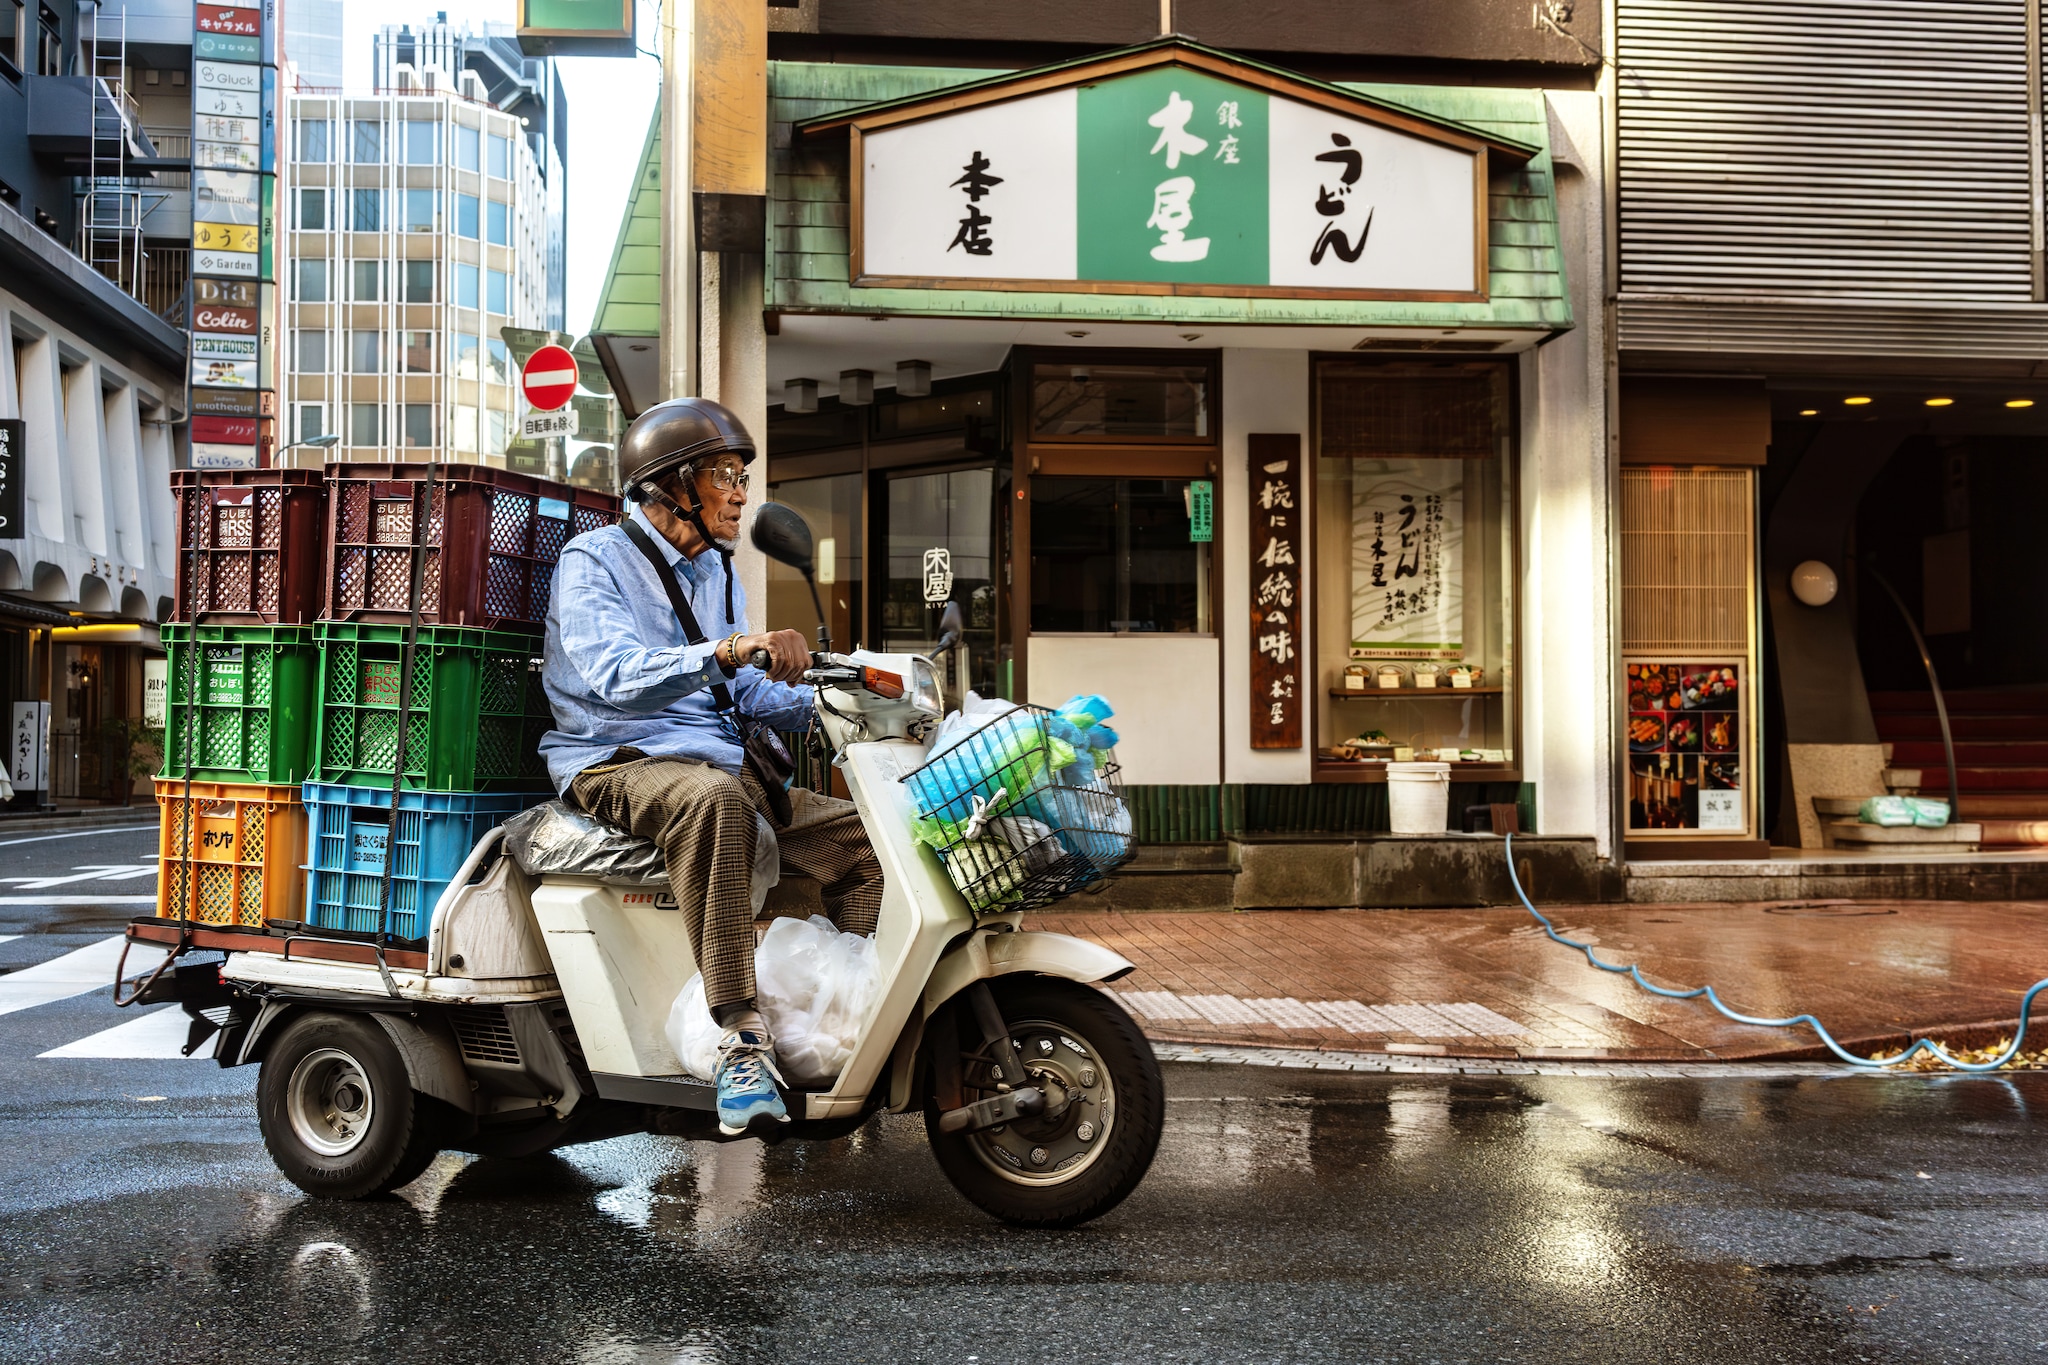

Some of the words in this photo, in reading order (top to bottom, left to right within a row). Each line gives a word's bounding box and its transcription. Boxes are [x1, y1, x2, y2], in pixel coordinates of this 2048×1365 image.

[219, 11, 235, 20] Bar
[200, 18, 256, 33] キャラメル
[217, 73, 254, 86] Gluck
[1212, 101, 1242, 165] 銀座
[1147, 91, 1212, 263] 木屋
[946, 151, 1004, 256] 本店
[1309, 133, 1375, 266] うどん
[216, 258, 252, 270] Garden
[197, 311, 253, 329] Colin
[195, 338, 255, 354] PENTHOUSE
[195, 402, 254, 412] enotheque
[525, 417, 573, 434] 自転車を除く
[219, 508, 252, 519] おしぼり
[377, 503, 412, 514] おしぼり
[1395, 494, 1421, 580] うどん
[1370, 538, 1388, 587] 木屋
[924, 547, 951, 601] 木屋
[925, 601, 948, 609] KIYA
[209, 678, 242, 688] おしぼり
[1269, 680, 1285, 725] 木屋
